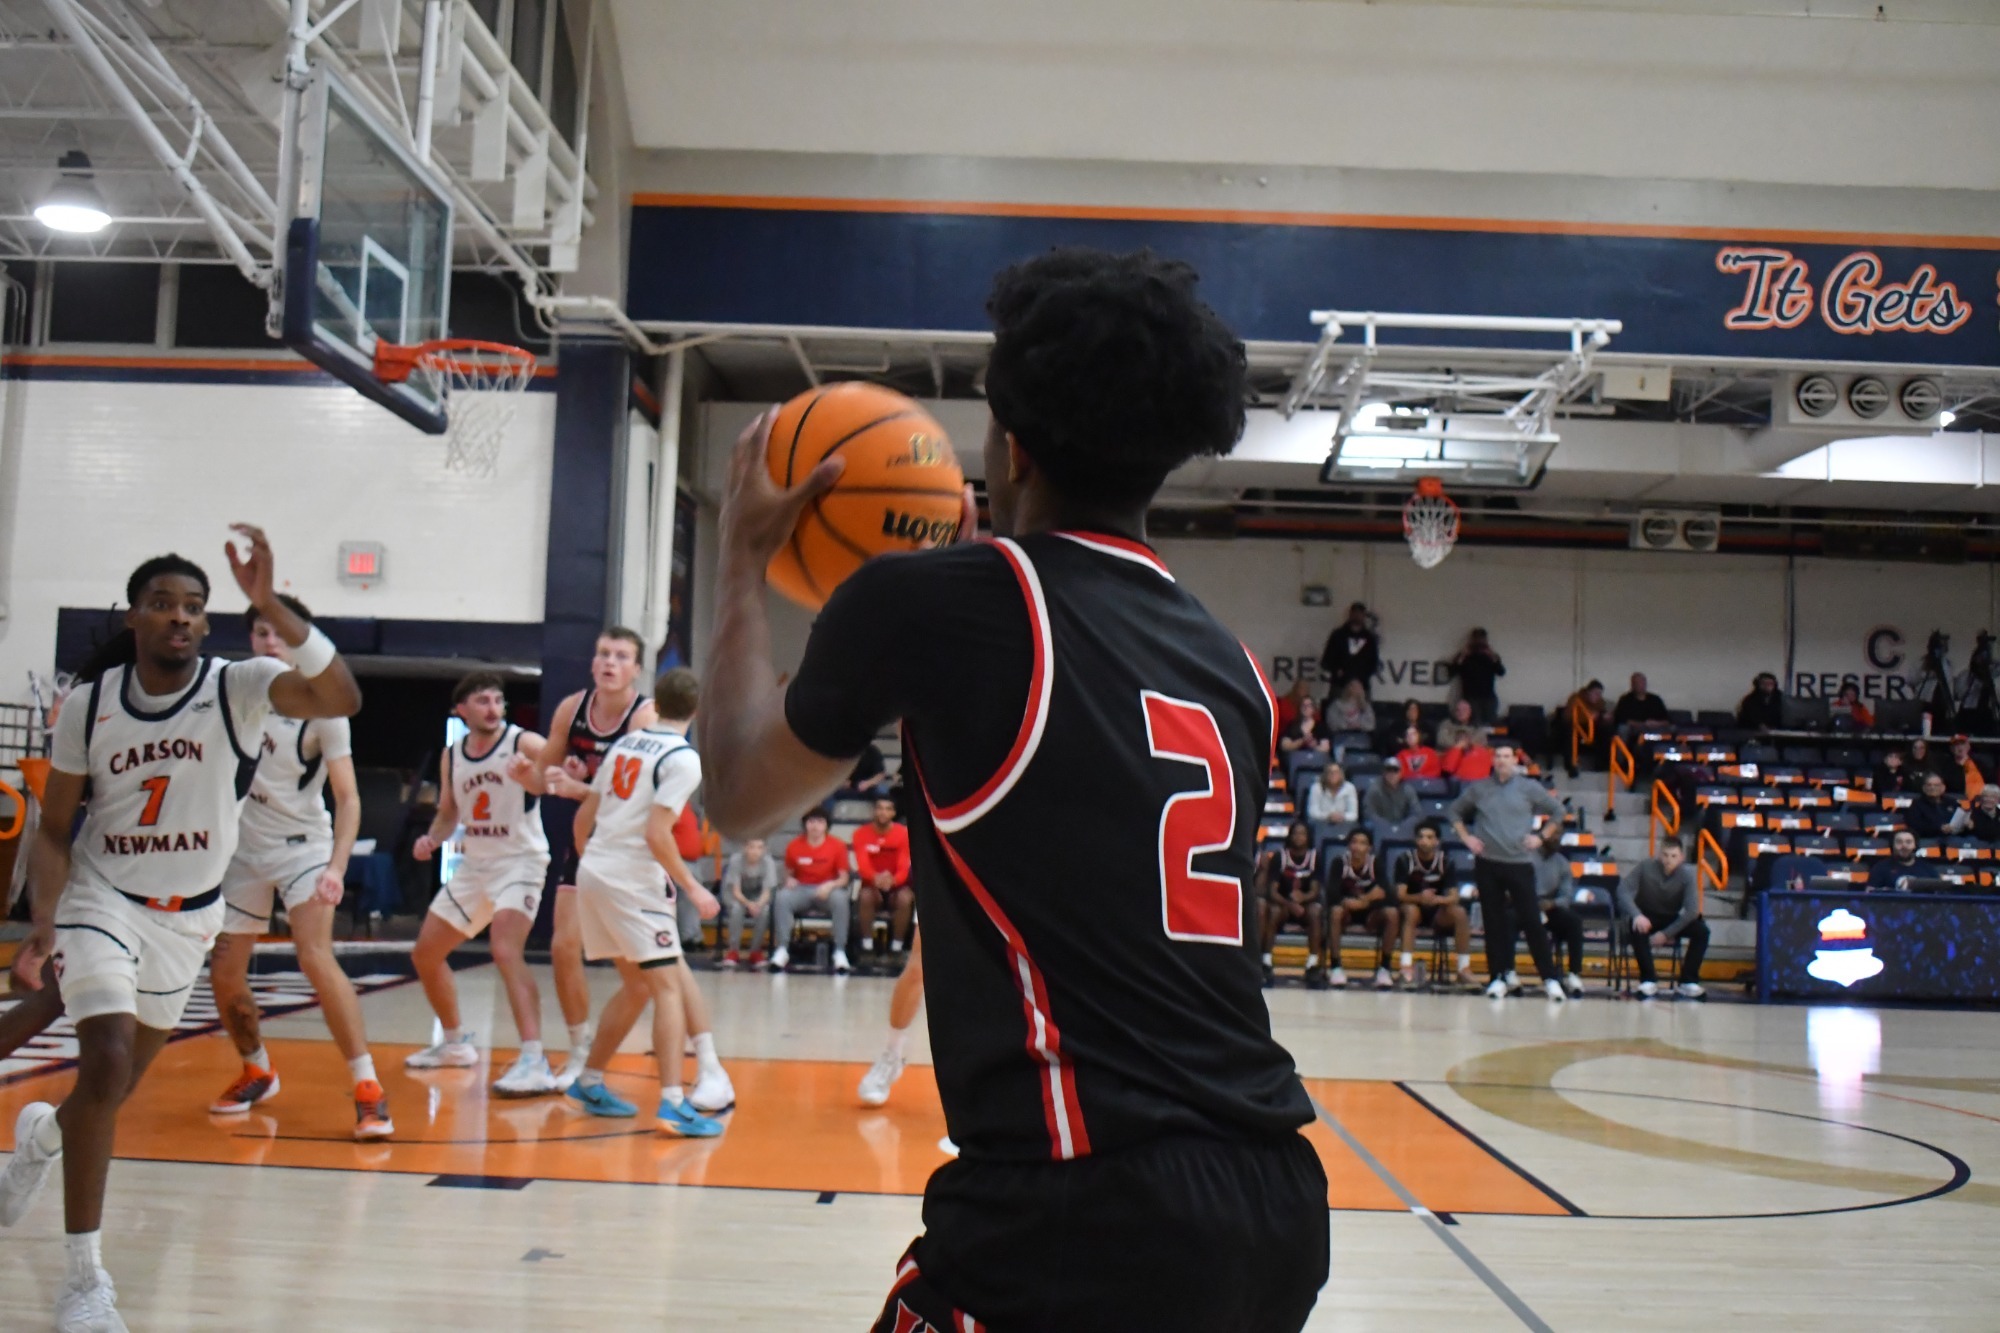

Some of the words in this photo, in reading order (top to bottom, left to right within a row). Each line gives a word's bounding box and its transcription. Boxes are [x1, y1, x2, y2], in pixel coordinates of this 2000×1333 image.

[1821, 252, 1972, 334] Gets
[1864, 627, 1903, 669] C
[109, 738, 204, 776] CARSON
[137, 775, 171, 827] 7
[472, 791, 491, 821] 2
[1140, 689, 1243, 947] 2
[103, 830, 209, 855] NEWMAN
